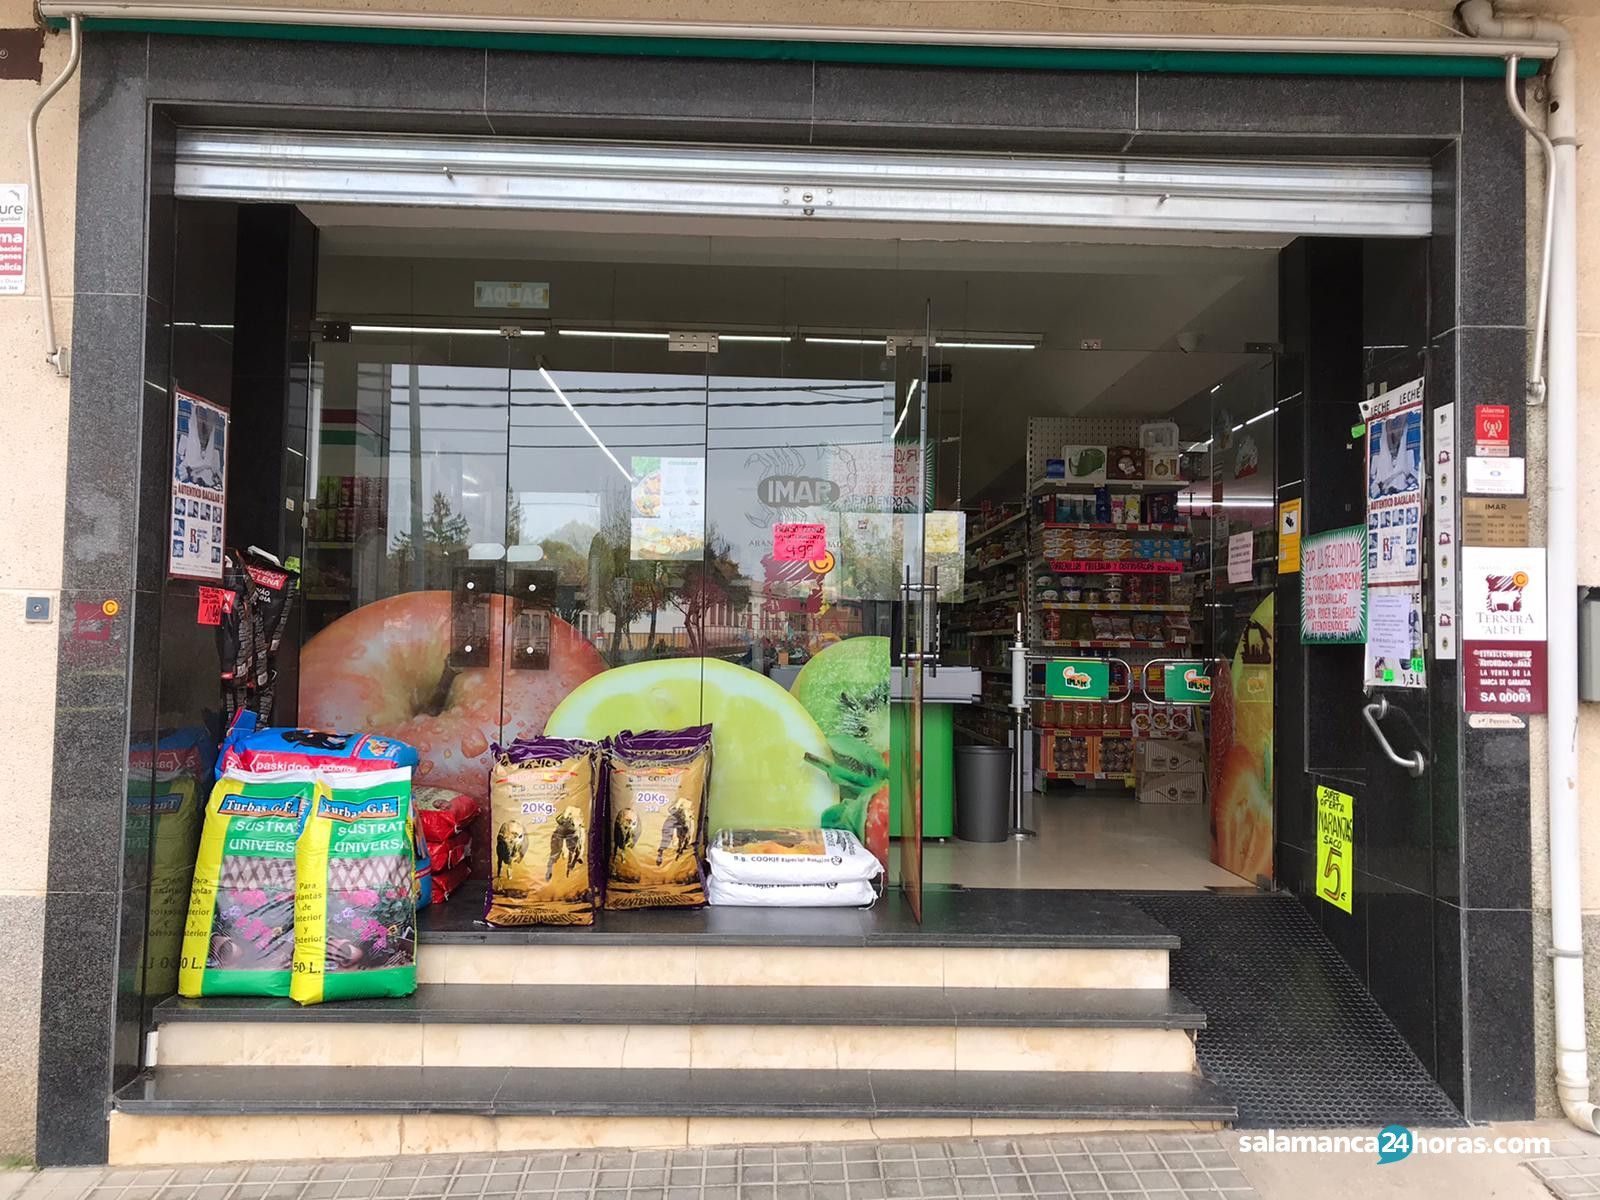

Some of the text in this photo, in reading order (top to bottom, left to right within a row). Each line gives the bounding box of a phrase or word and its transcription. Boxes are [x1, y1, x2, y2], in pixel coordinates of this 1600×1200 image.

[1370, 387, 1421, 416] LECHE LECHE
[767, 480, 832, 502] IMAR
[1476, 612, 1535, 624] TERNERA
[1480, 692, 1532, 703] SA 00001
[227, 799, 266, 813] Turbas
[637, 793, 669, 805] 20Kg.
[522, 803, 557, 815] 20Kg.
[1323, 835, 1342, 849] SACO
[1323, 847, 1342, 901] 5
